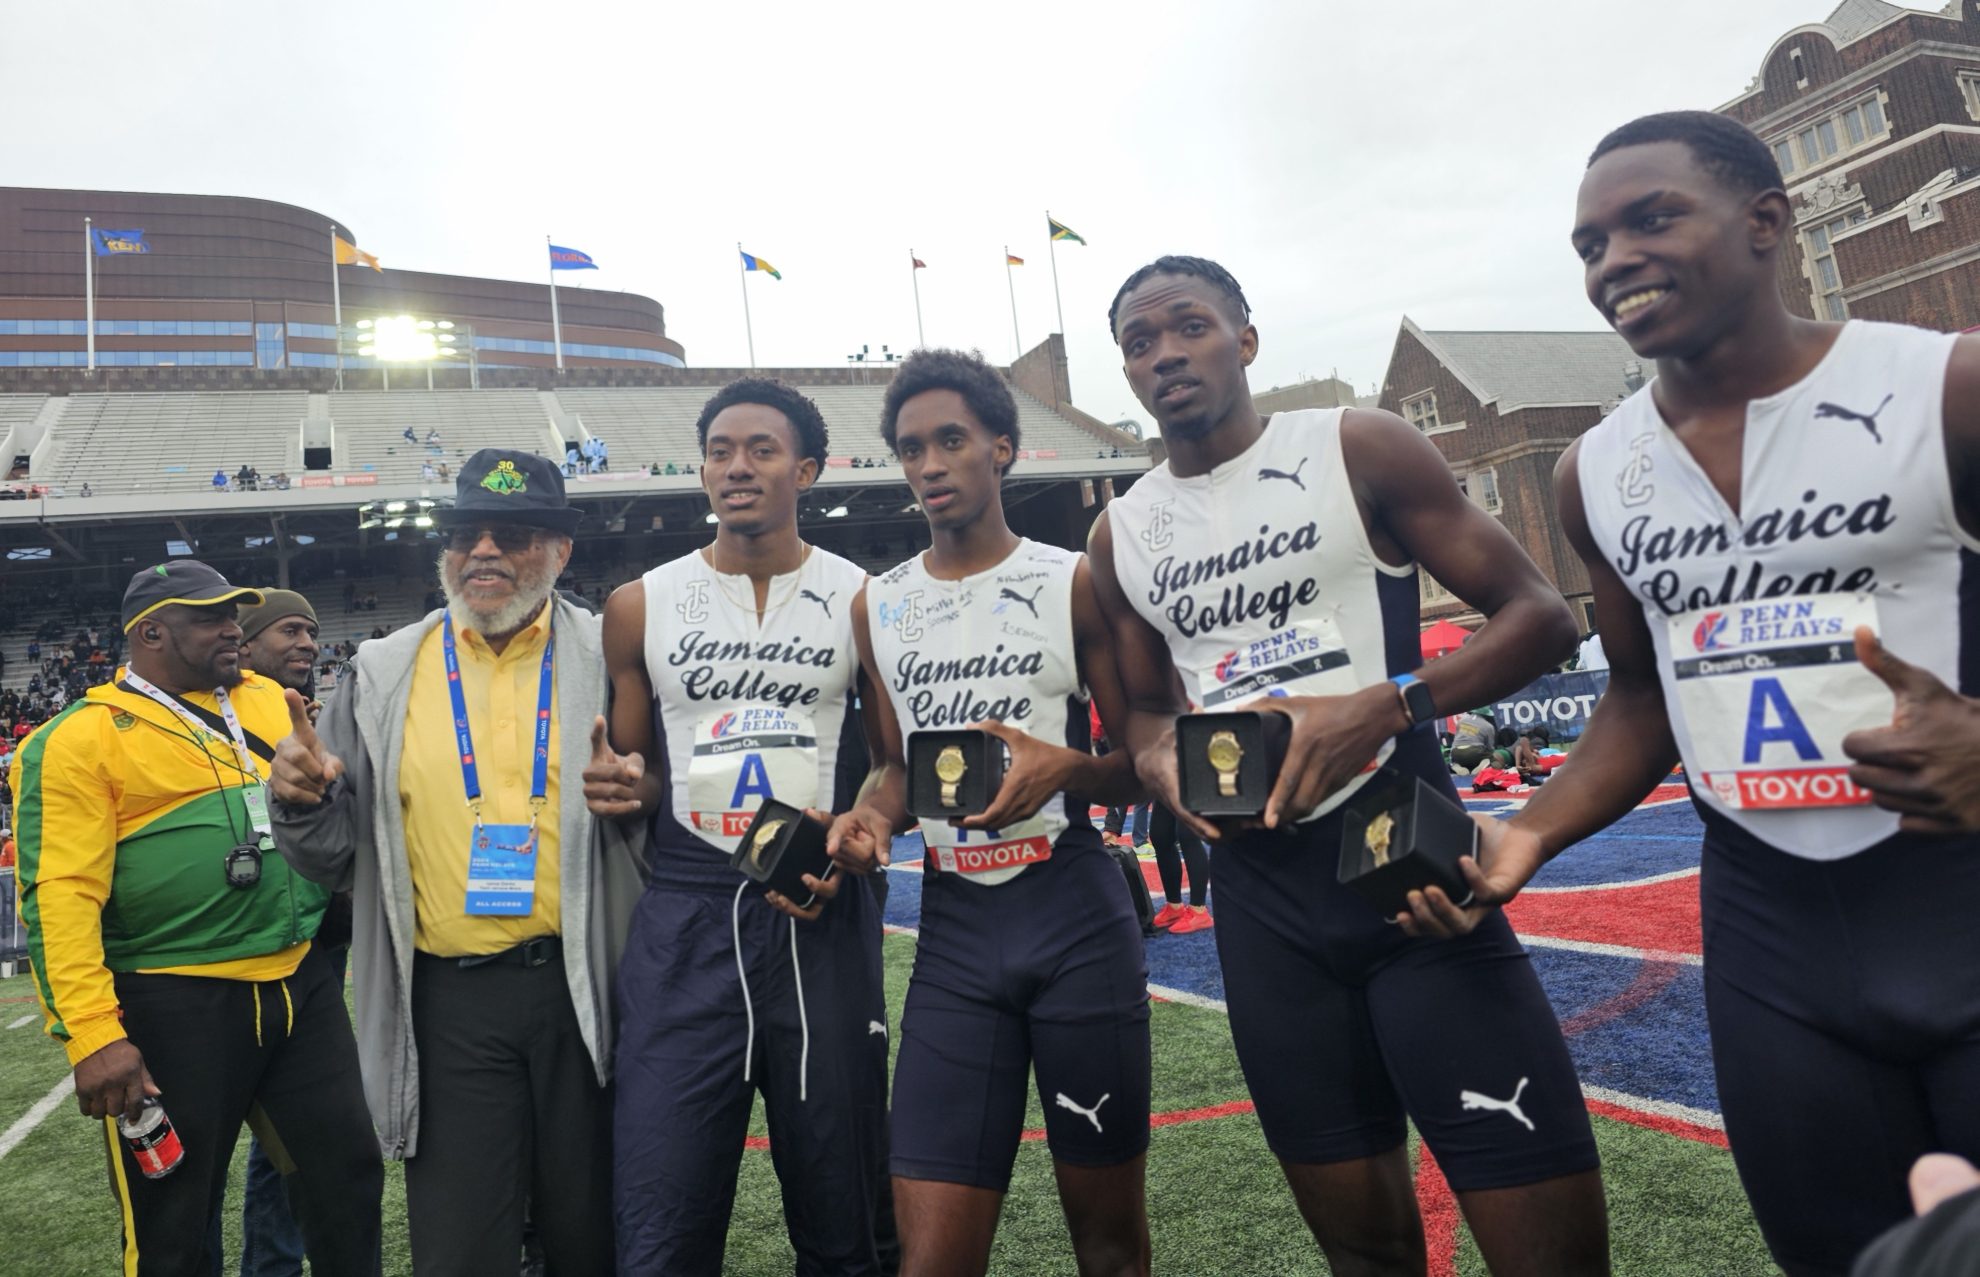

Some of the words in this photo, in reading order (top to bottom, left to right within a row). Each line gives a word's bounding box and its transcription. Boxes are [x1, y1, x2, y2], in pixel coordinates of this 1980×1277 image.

[498, 460, 514, 470] 30
[1617, 489, 1897, 577] Jamaica
[1148, 521, 1322, 606] Jamaica
[1165, 577, 1320, 638] College
[1740, 601, 1815, 626] PENN
[1249, 628, 1297, 654] PENN
[1740, 617, 1844, 645] RELAYS
[668, 631, 836, 668] Jamaica
[1249, 636, 1320, 668] RELAYS
[1699, 657, 1743, 675] Dream
[1744, 653, 1775, 669] On.
[893, 644, 1044, 692] Jamaica
[680, 665, 820, 708] College
[1224, 680, 1259, 700] Dream
[743, 708, 786, 720] PENN
[907, 689, 1032, 729] College
[1497, 693, 1605, 725] TOYOT
[1743, 677, 1825, 764] A
[741, 720, 799, 732] RELAYS
[712, 741, 742, 753] Dream
[730, 753, 775, 809] A
[1742, 773, 1870, 801] TOYOT
[957, 842, 1038, 868] TOYOTA
